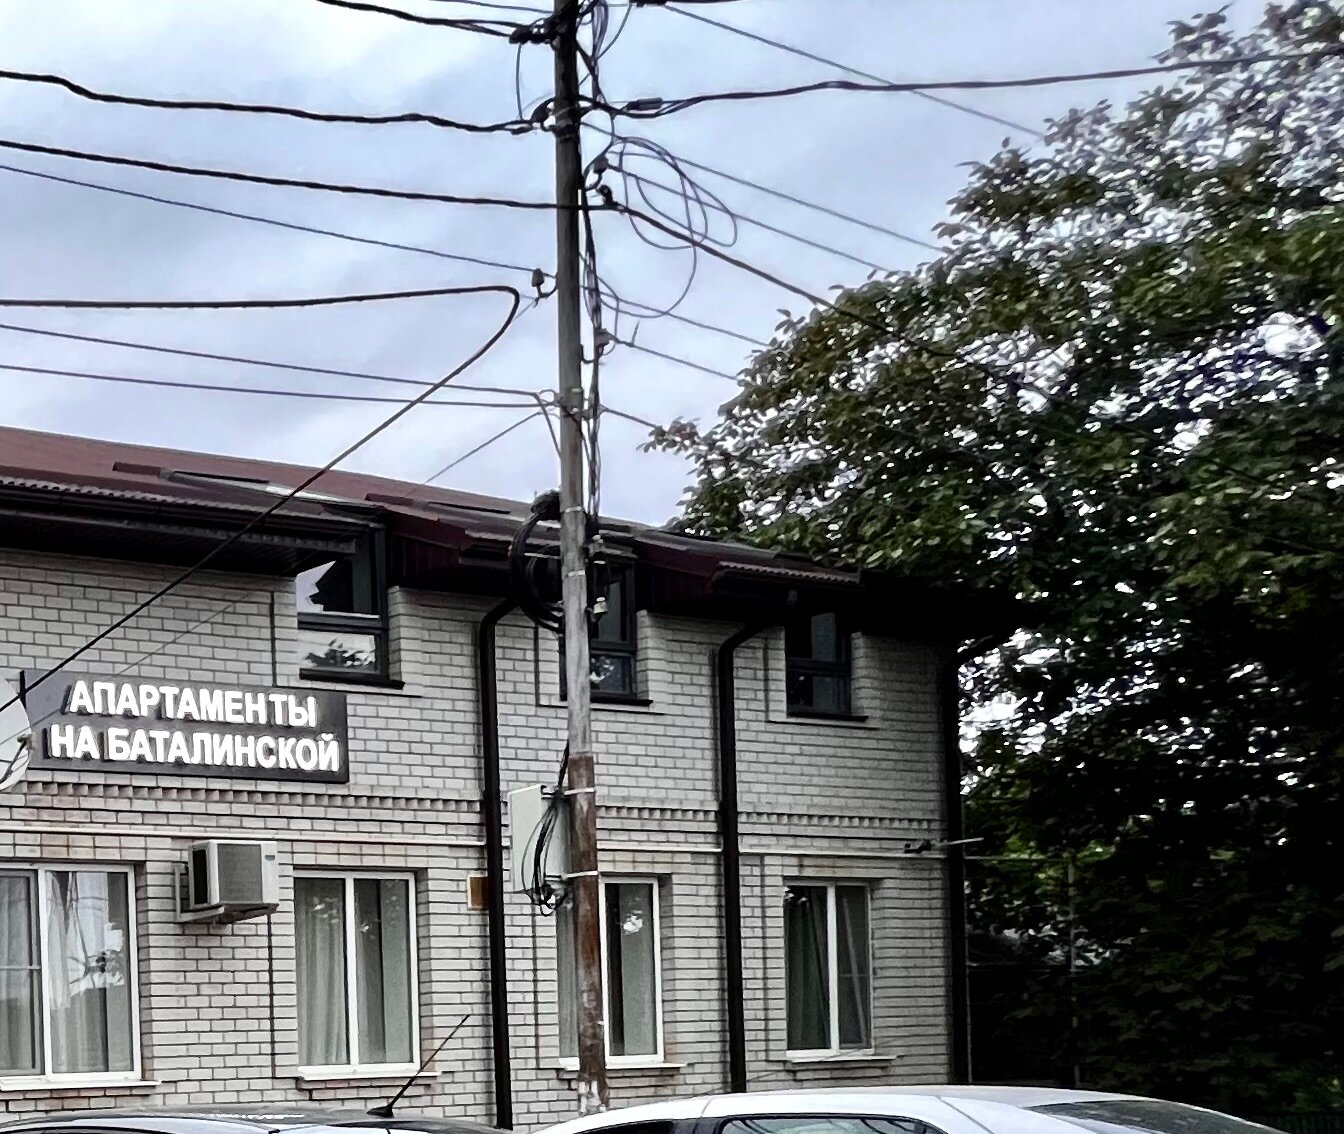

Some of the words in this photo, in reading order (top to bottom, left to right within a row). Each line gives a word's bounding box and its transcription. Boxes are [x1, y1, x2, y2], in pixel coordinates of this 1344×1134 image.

[69, 680, 317, 727] АПАРТАМЕНТЫ
[50, 723, 99, 760] НА
[107, 727, 339, 772] БАТАЛИНСКОЙ
